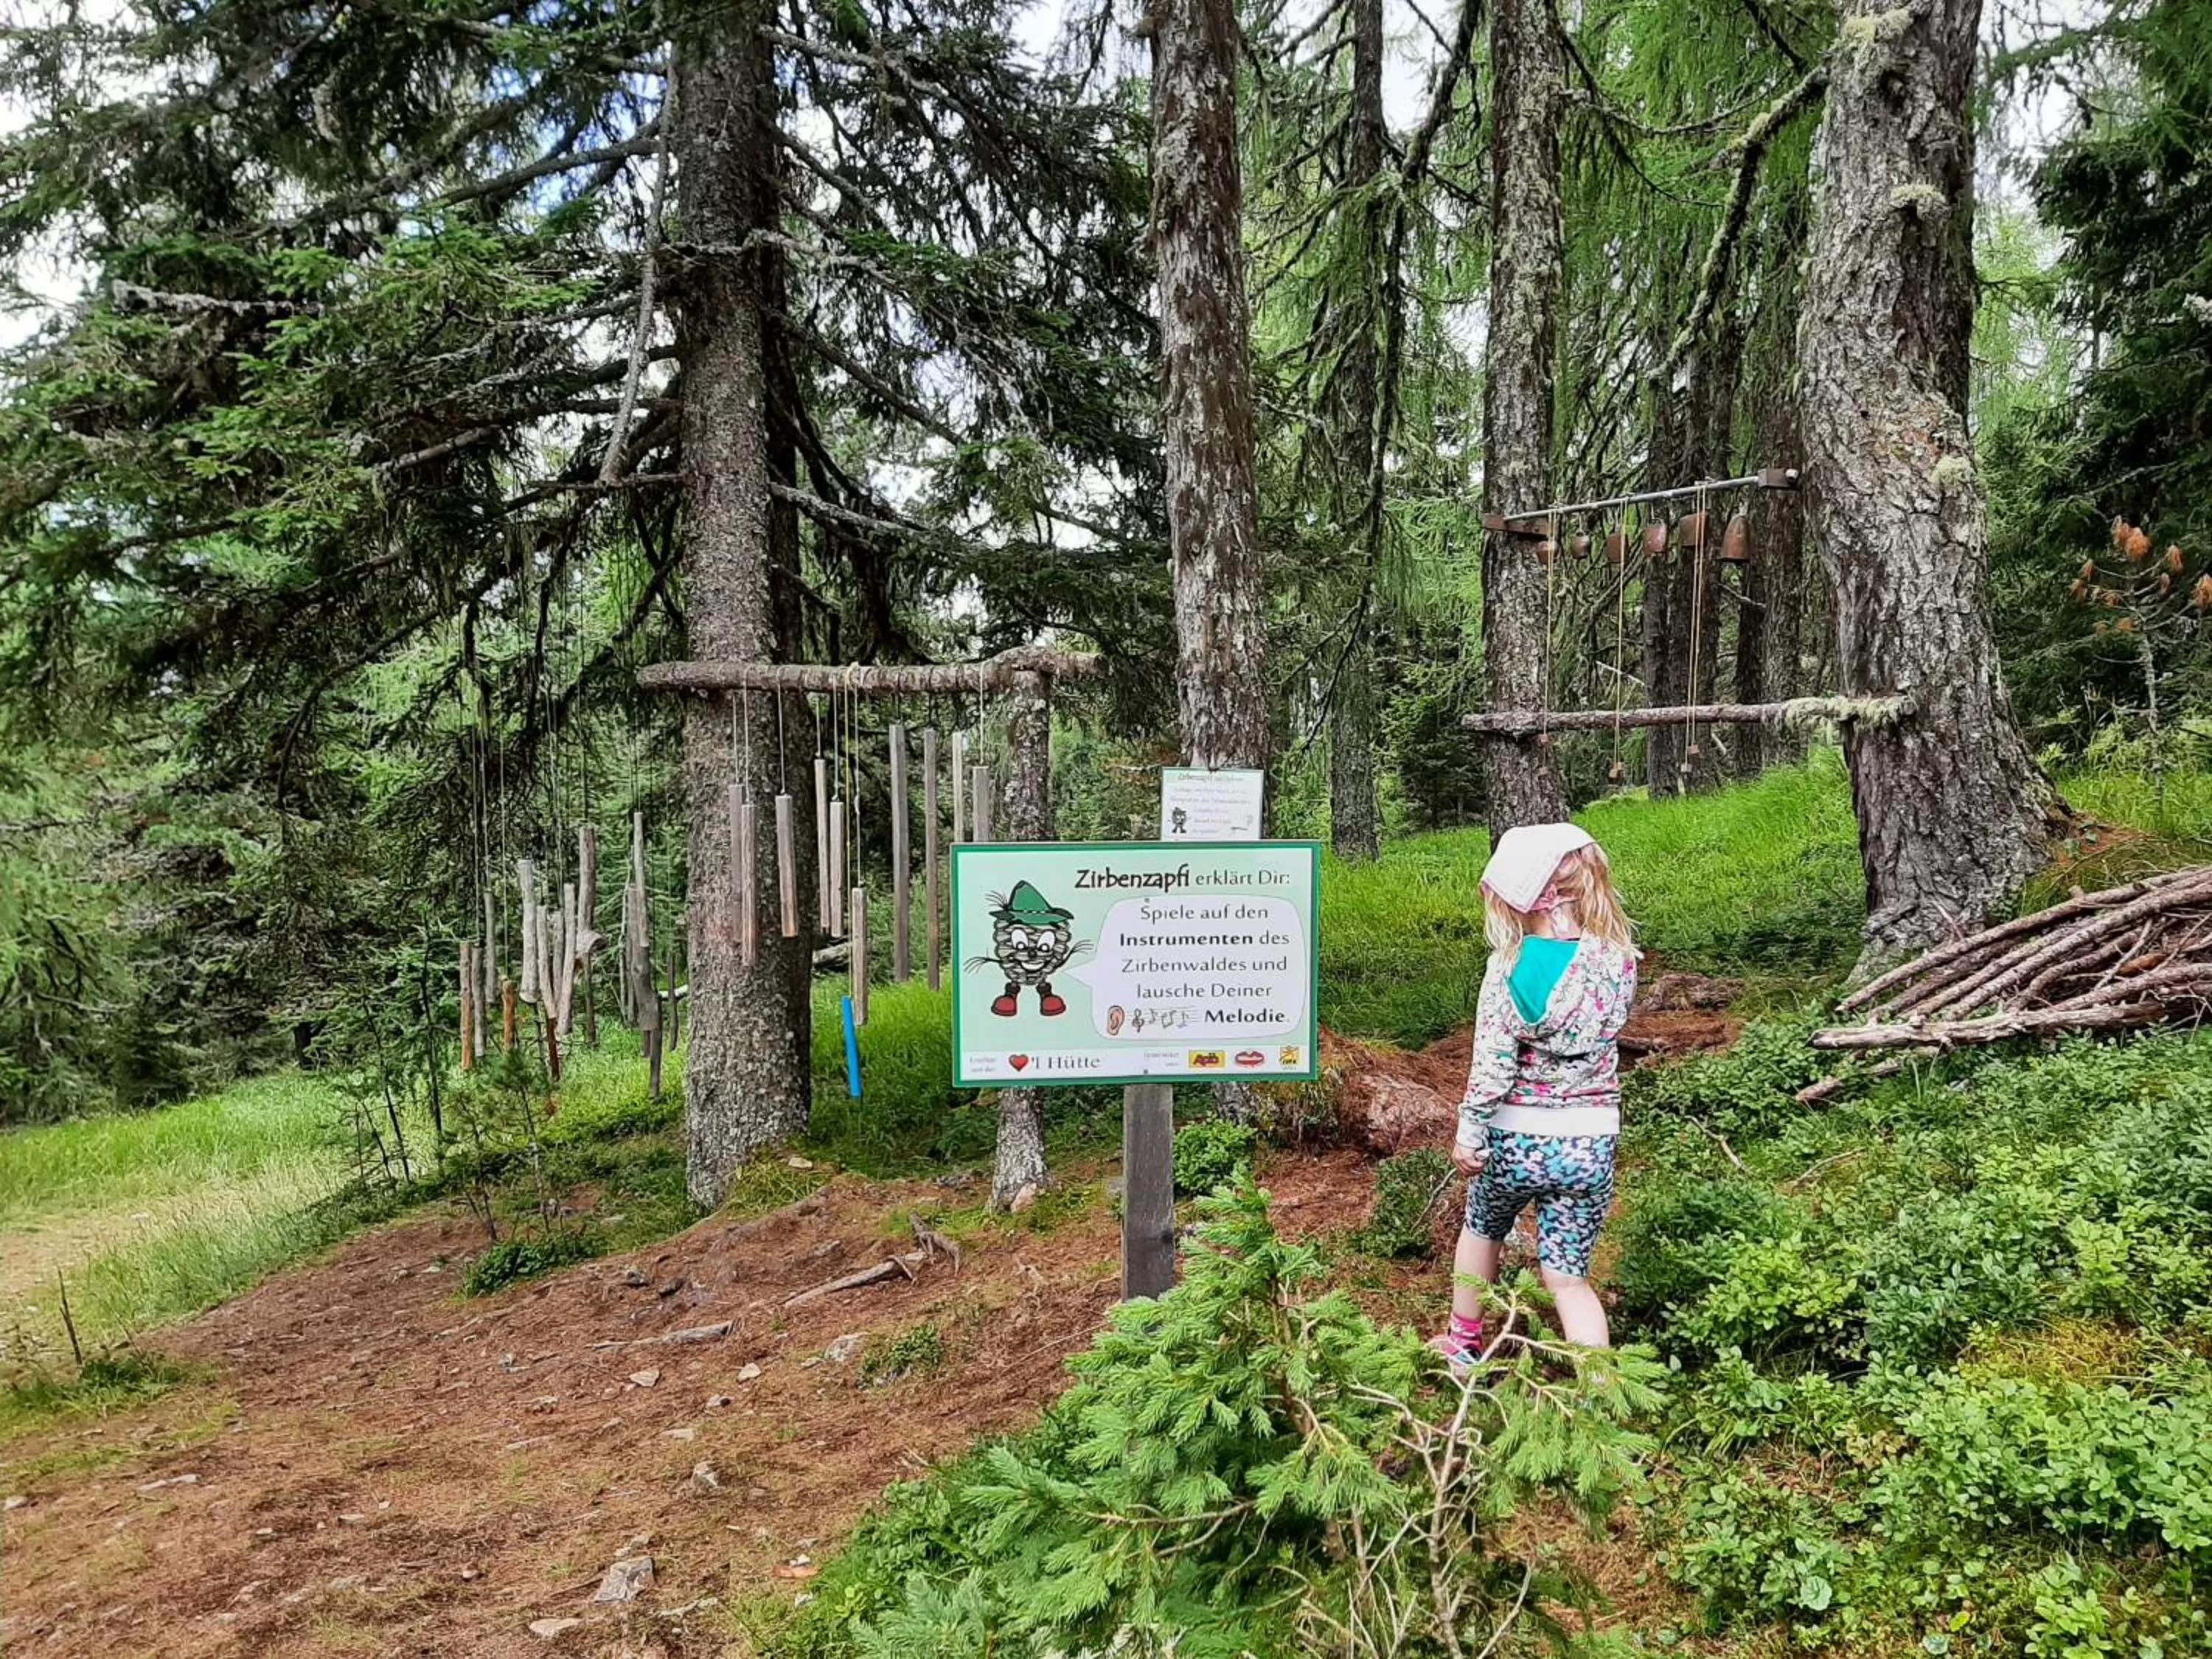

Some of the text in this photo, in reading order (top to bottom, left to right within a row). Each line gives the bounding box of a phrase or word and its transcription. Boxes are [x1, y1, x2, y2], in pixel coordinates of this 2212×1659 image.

[1195, 870, 1252, 886] erklärt
[1258, 870, 1290, 886] Dir:
[1140, 905, 1268, 925] Spiele auf den
[1119, 932, 1290, 947] Instrumenten des
[1121, 958, 1287, 973] Zirbenwaldes und
[1137, 984, 1273, 998] lausche Deiner
[1048, 1056, 1101, 1069] Hütte
